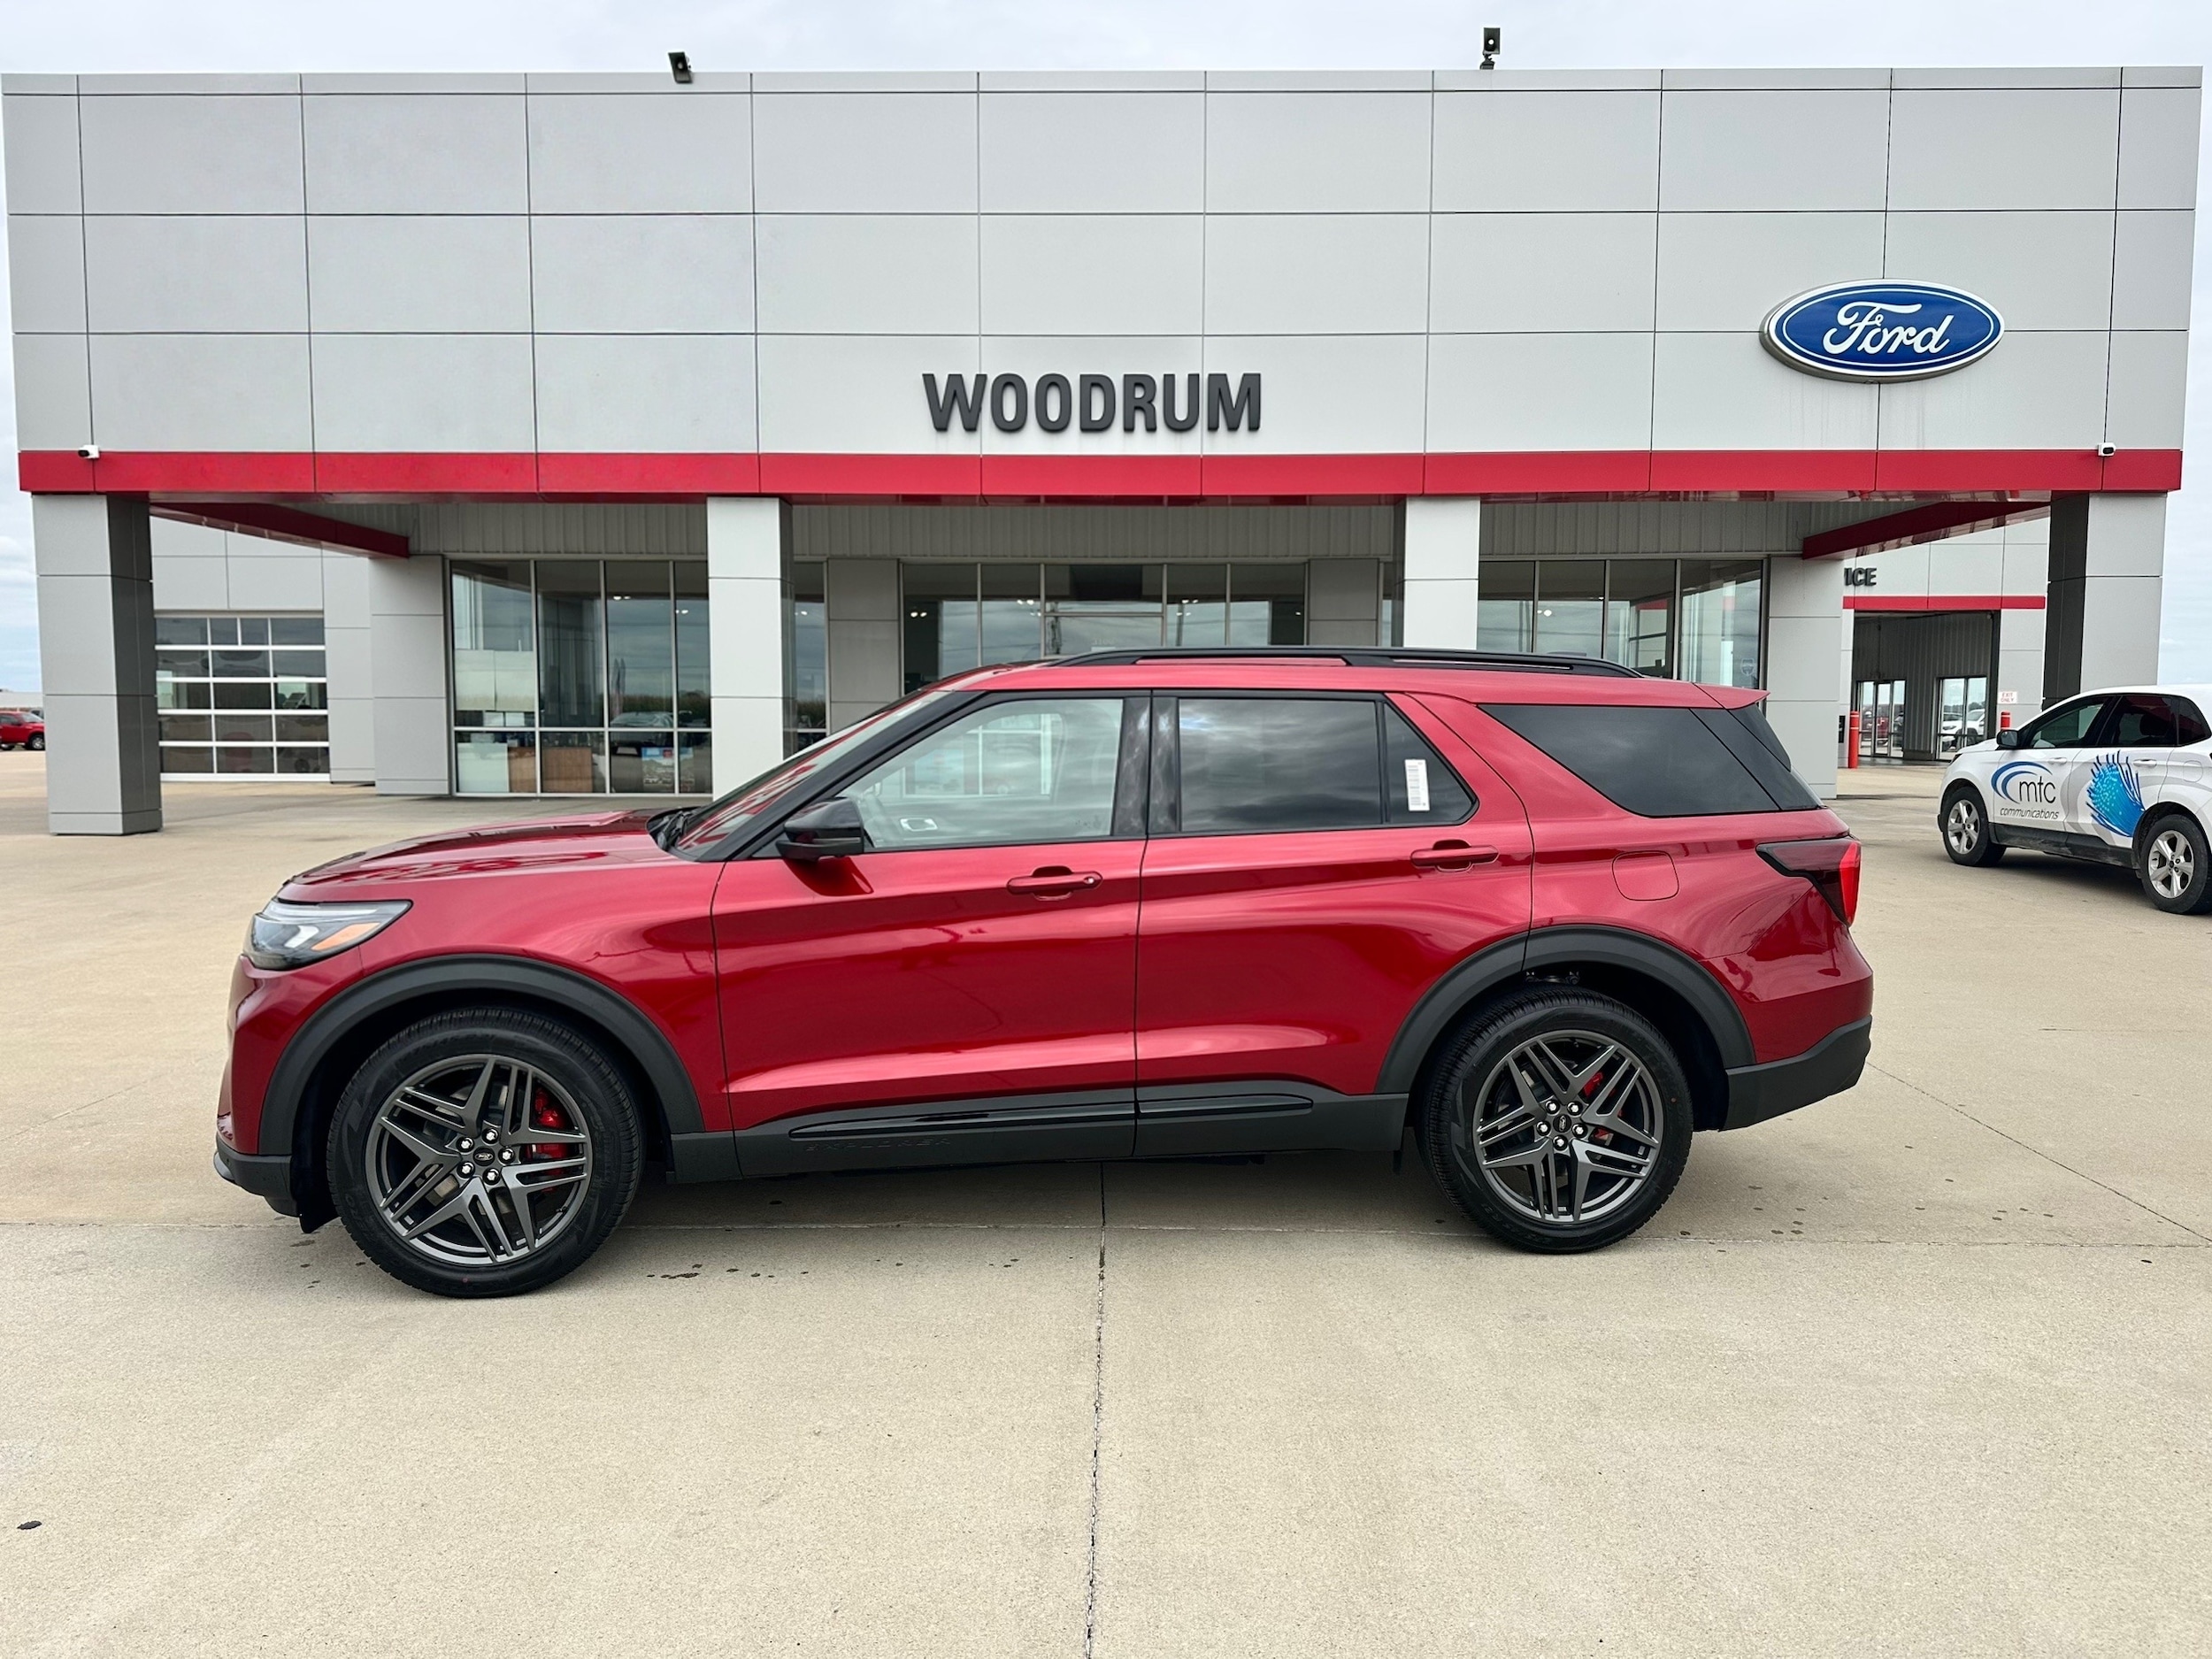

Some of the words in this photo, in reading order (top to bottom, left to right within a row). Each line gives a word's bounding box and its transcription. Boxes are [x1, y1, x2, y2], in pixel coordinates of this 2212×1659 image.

[1823, 300, 1955, 355] Ford
[922, 373, 1262, 432] WOODRUM
[1844, 567, 1877, 586] ICE
[2019, 776, 2056, 803] mtc
[2000, 807, 2060, 819] communications
[804, 1138, 951, 1151] EXPLORER
